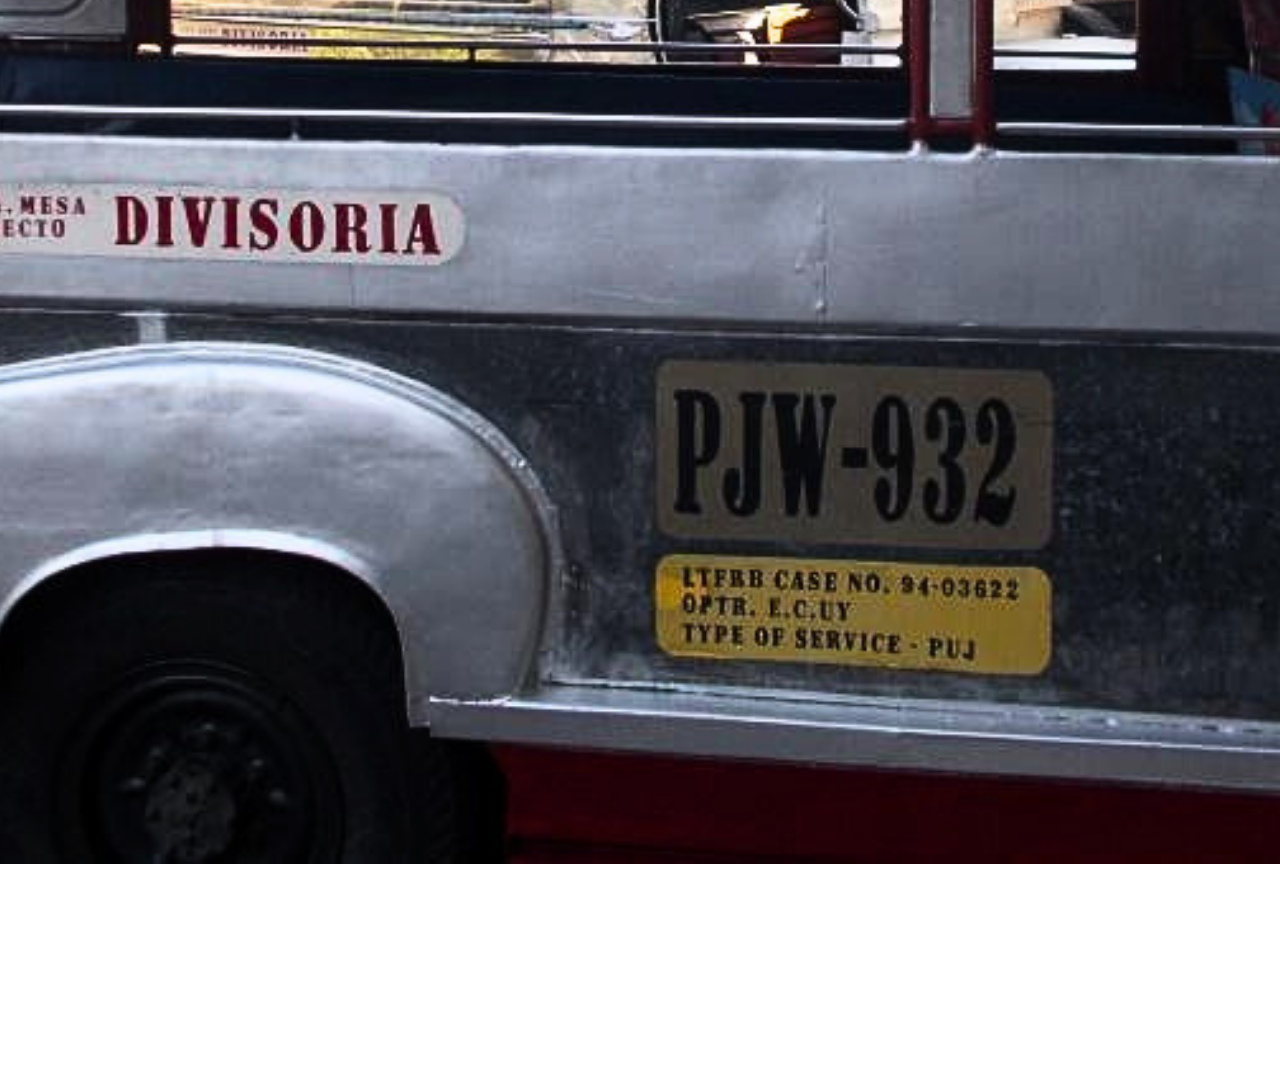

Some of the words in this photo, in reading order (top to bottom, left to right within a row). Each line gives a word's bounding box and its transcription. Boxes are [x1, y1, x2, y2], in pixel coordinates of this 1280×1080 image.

[115, 195, 441, 256] DIVISORIA
[674, 389, 1018, 526] PJW-932
[682, 567, 764, 589] LTFRB
[775, 570, 838, 594] CASE
[849, 573, 891, 595] NO.
[682, 593, 756, 618] OPTR.
[683, 624, 744, 646] TYPE
[755, 626, 785, 647] OF
[796, 630, 902, 654] SERVICE
[929, 637, 977, 661] PUJ
